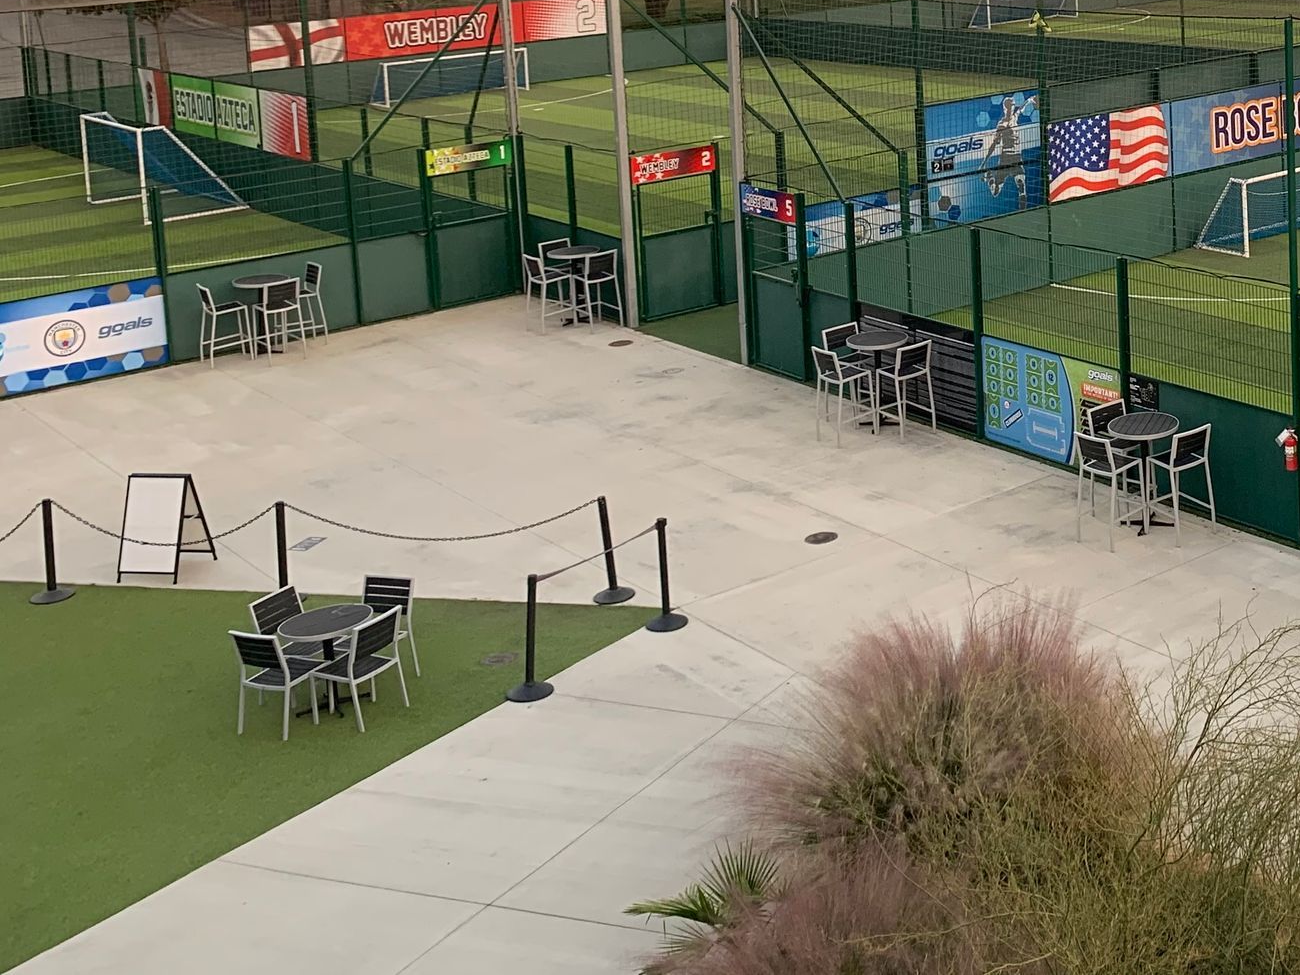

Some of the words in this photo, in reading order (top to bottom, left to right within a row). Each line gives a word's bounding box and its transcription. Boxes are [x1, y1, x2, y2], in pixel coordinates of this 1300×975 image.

[384, 13, 487, 49] WEMBLEY
[174, 89, 214, 123] ESTADIO
[215, 96, 257, 133] AZTECA
[291, 100, 300, 154] 1
[1212, 96, 1277, 151] ROSE
[500, 145, 505, 159] 1
[934, 137, 983, 158] goals
[640, 158, 679, 174] WEMBLEY
[701, 151, 711, 166] 2
[933, 162, 940, 173] 2
[785, 199, 793, 216] 5
[98, 316, 153, 339] goals
[1088, 369, 1113, 382] goals
